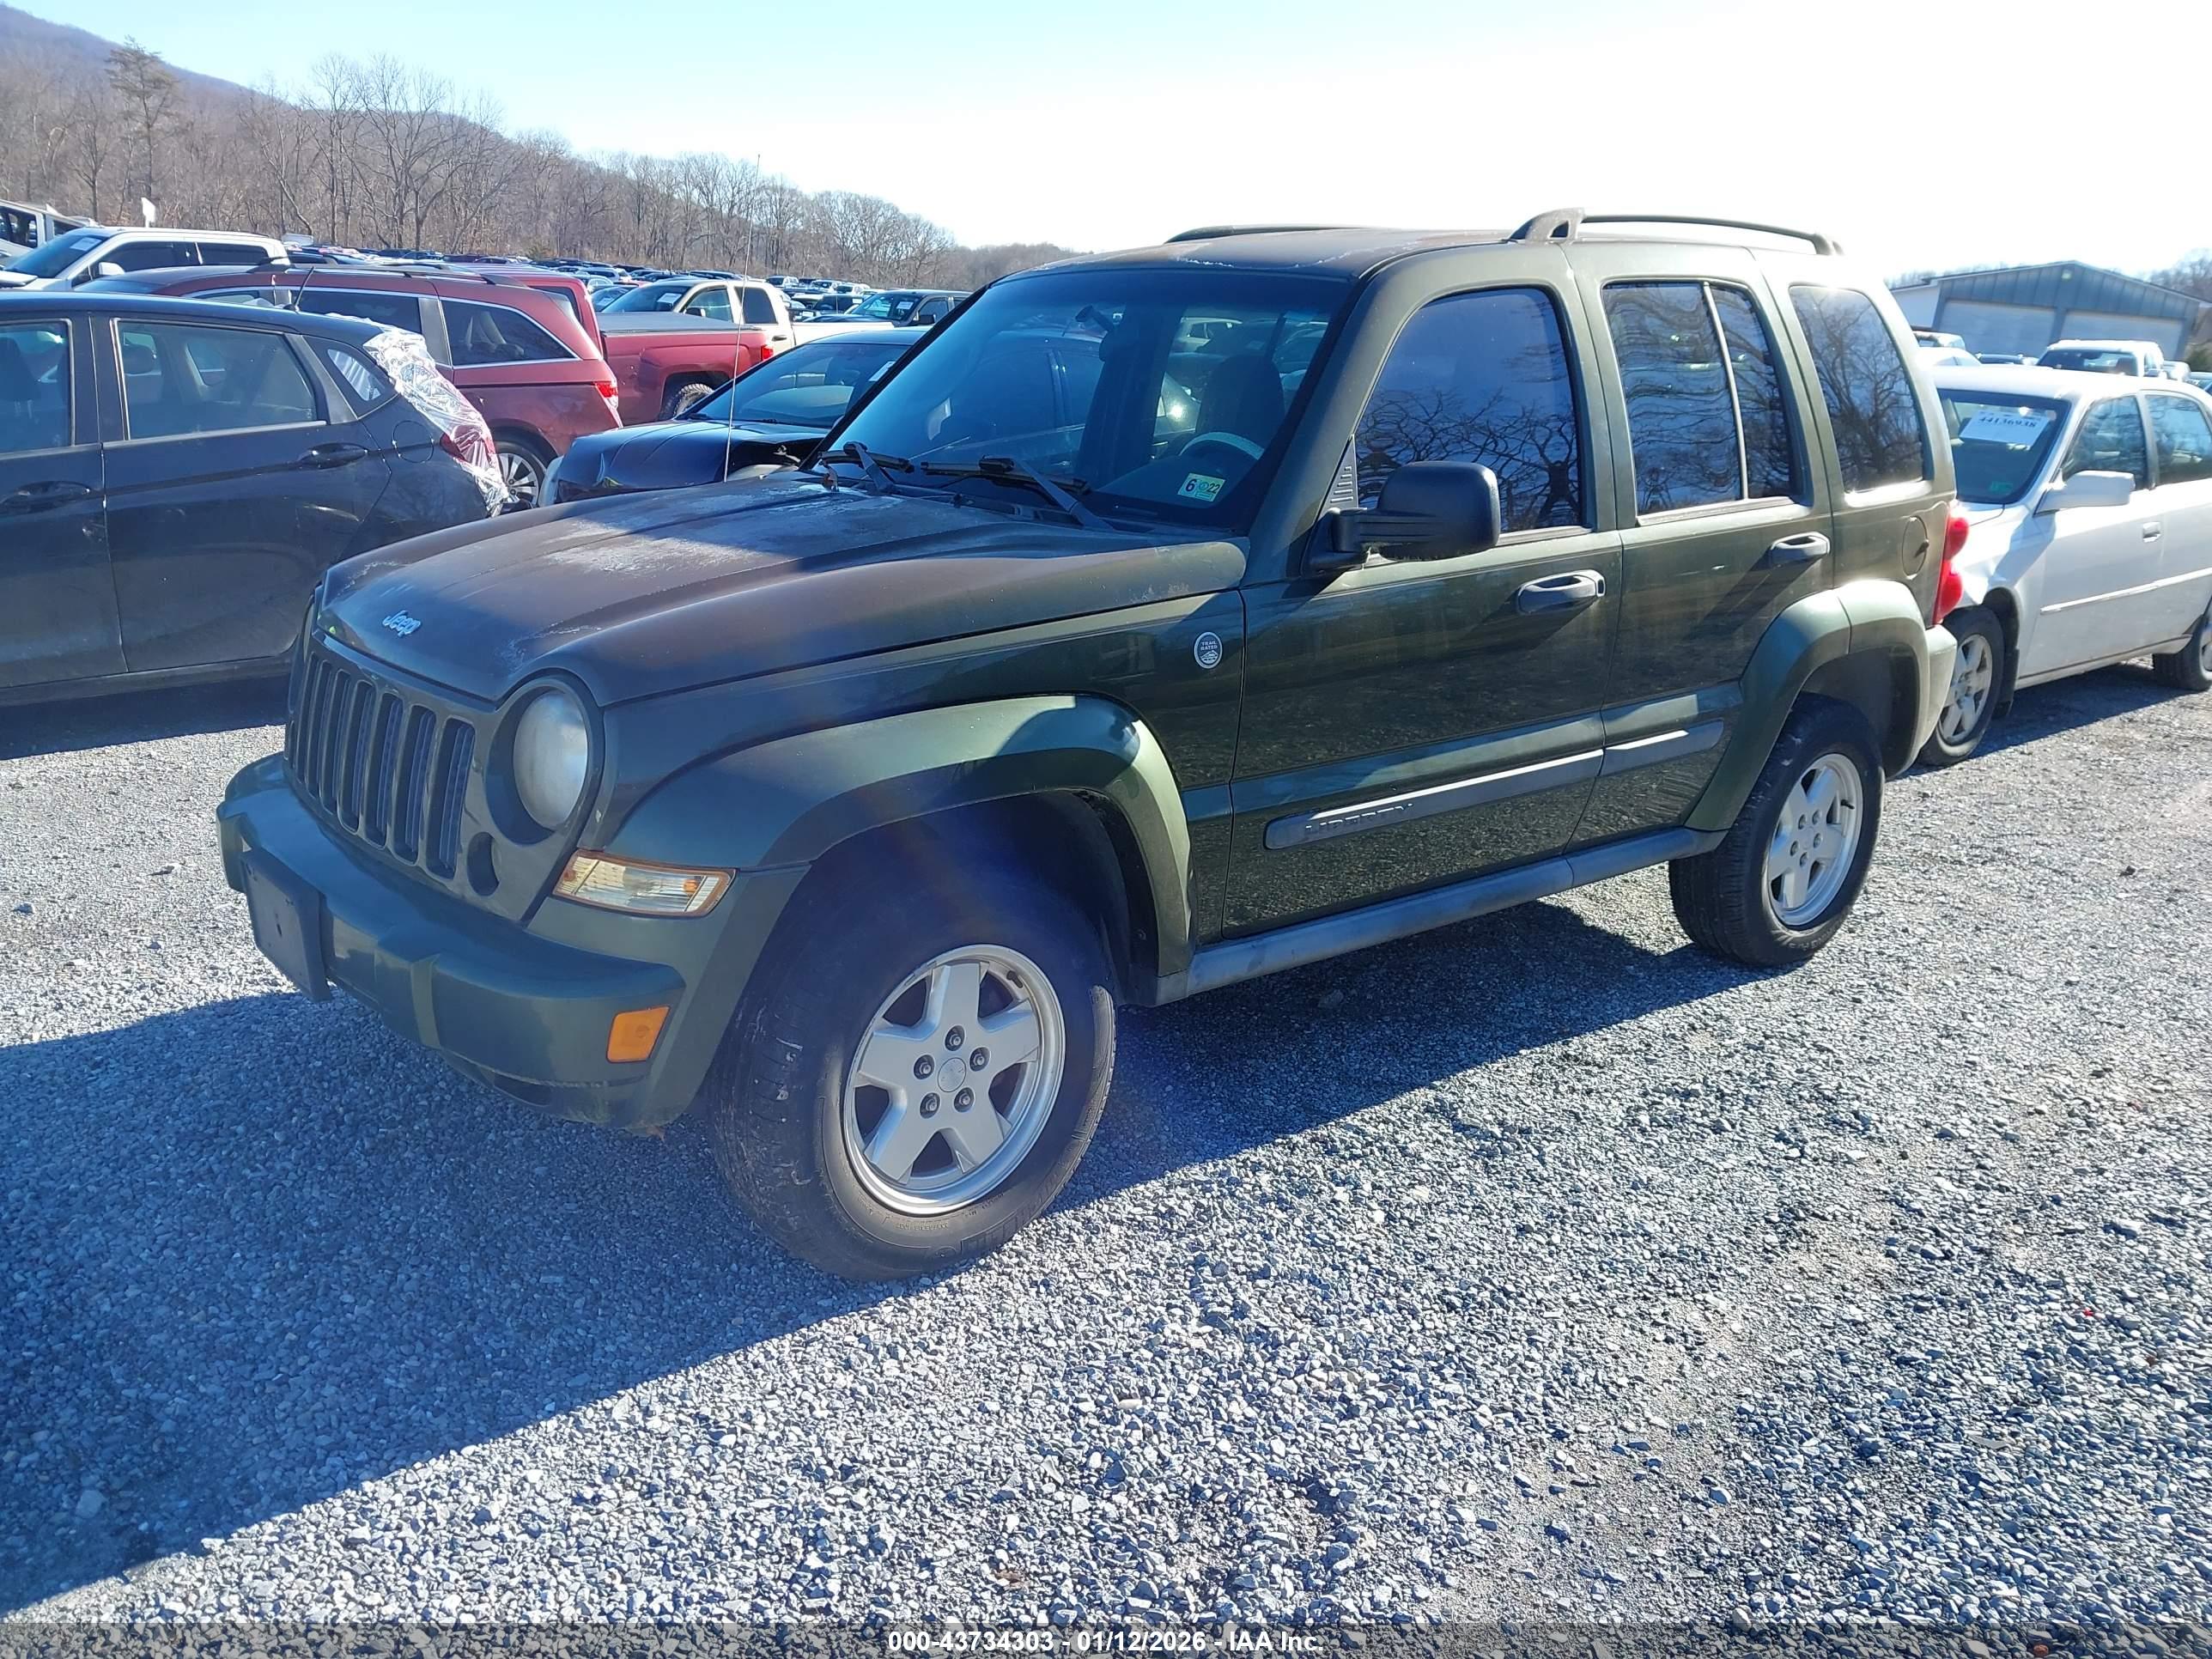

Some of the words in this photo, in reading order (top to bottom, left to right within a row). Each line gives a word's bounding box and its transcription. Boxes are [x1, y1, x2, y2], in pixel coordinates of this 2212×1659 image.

[1186, 479, 1196, 492] 6
[1206, 483, 1220, 494] 22
[382, 610, 421, 637] Jeep
